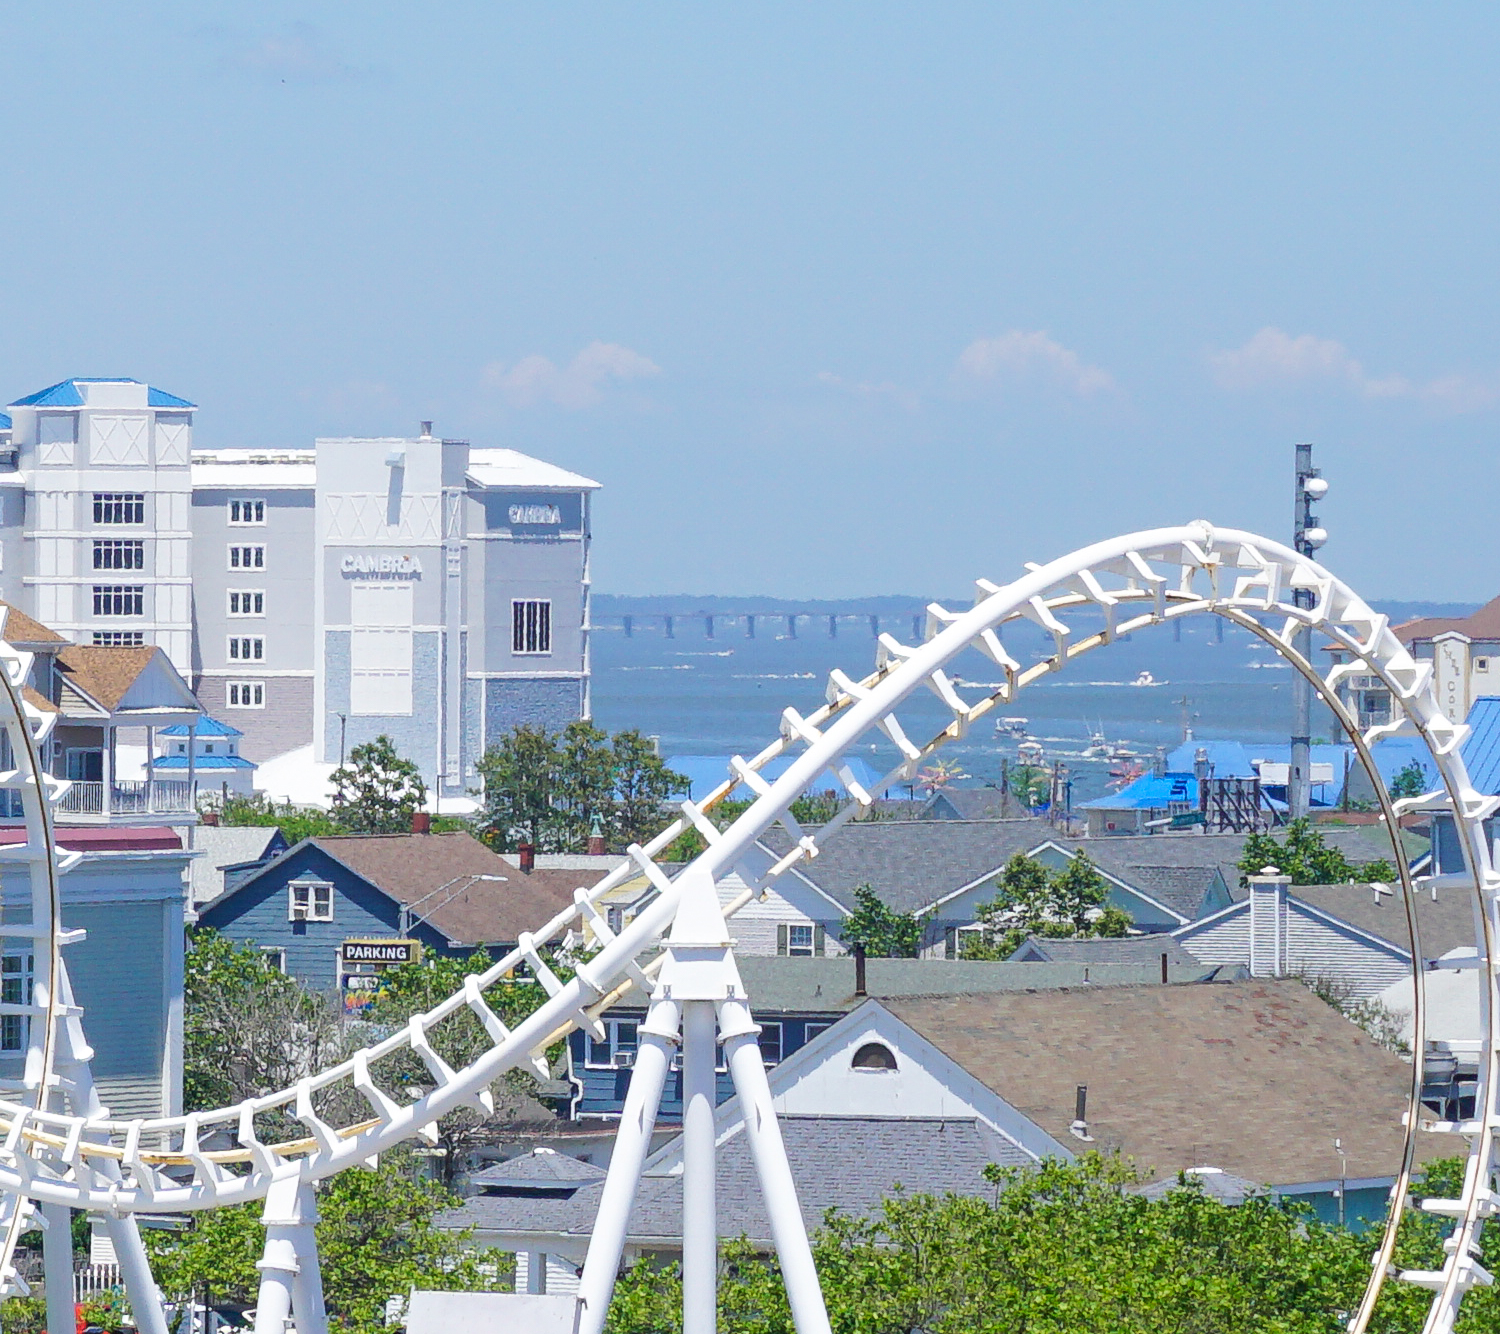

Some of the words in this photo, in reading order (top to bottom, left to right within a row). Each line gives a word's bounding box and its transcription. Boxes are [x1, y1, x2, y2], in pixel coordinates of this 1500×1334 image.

[508, 504, 561, 524] CAMBRIA
[341, 554, 422, 573] CAMBRIA
[346, 946, 407, 959] PARKING
